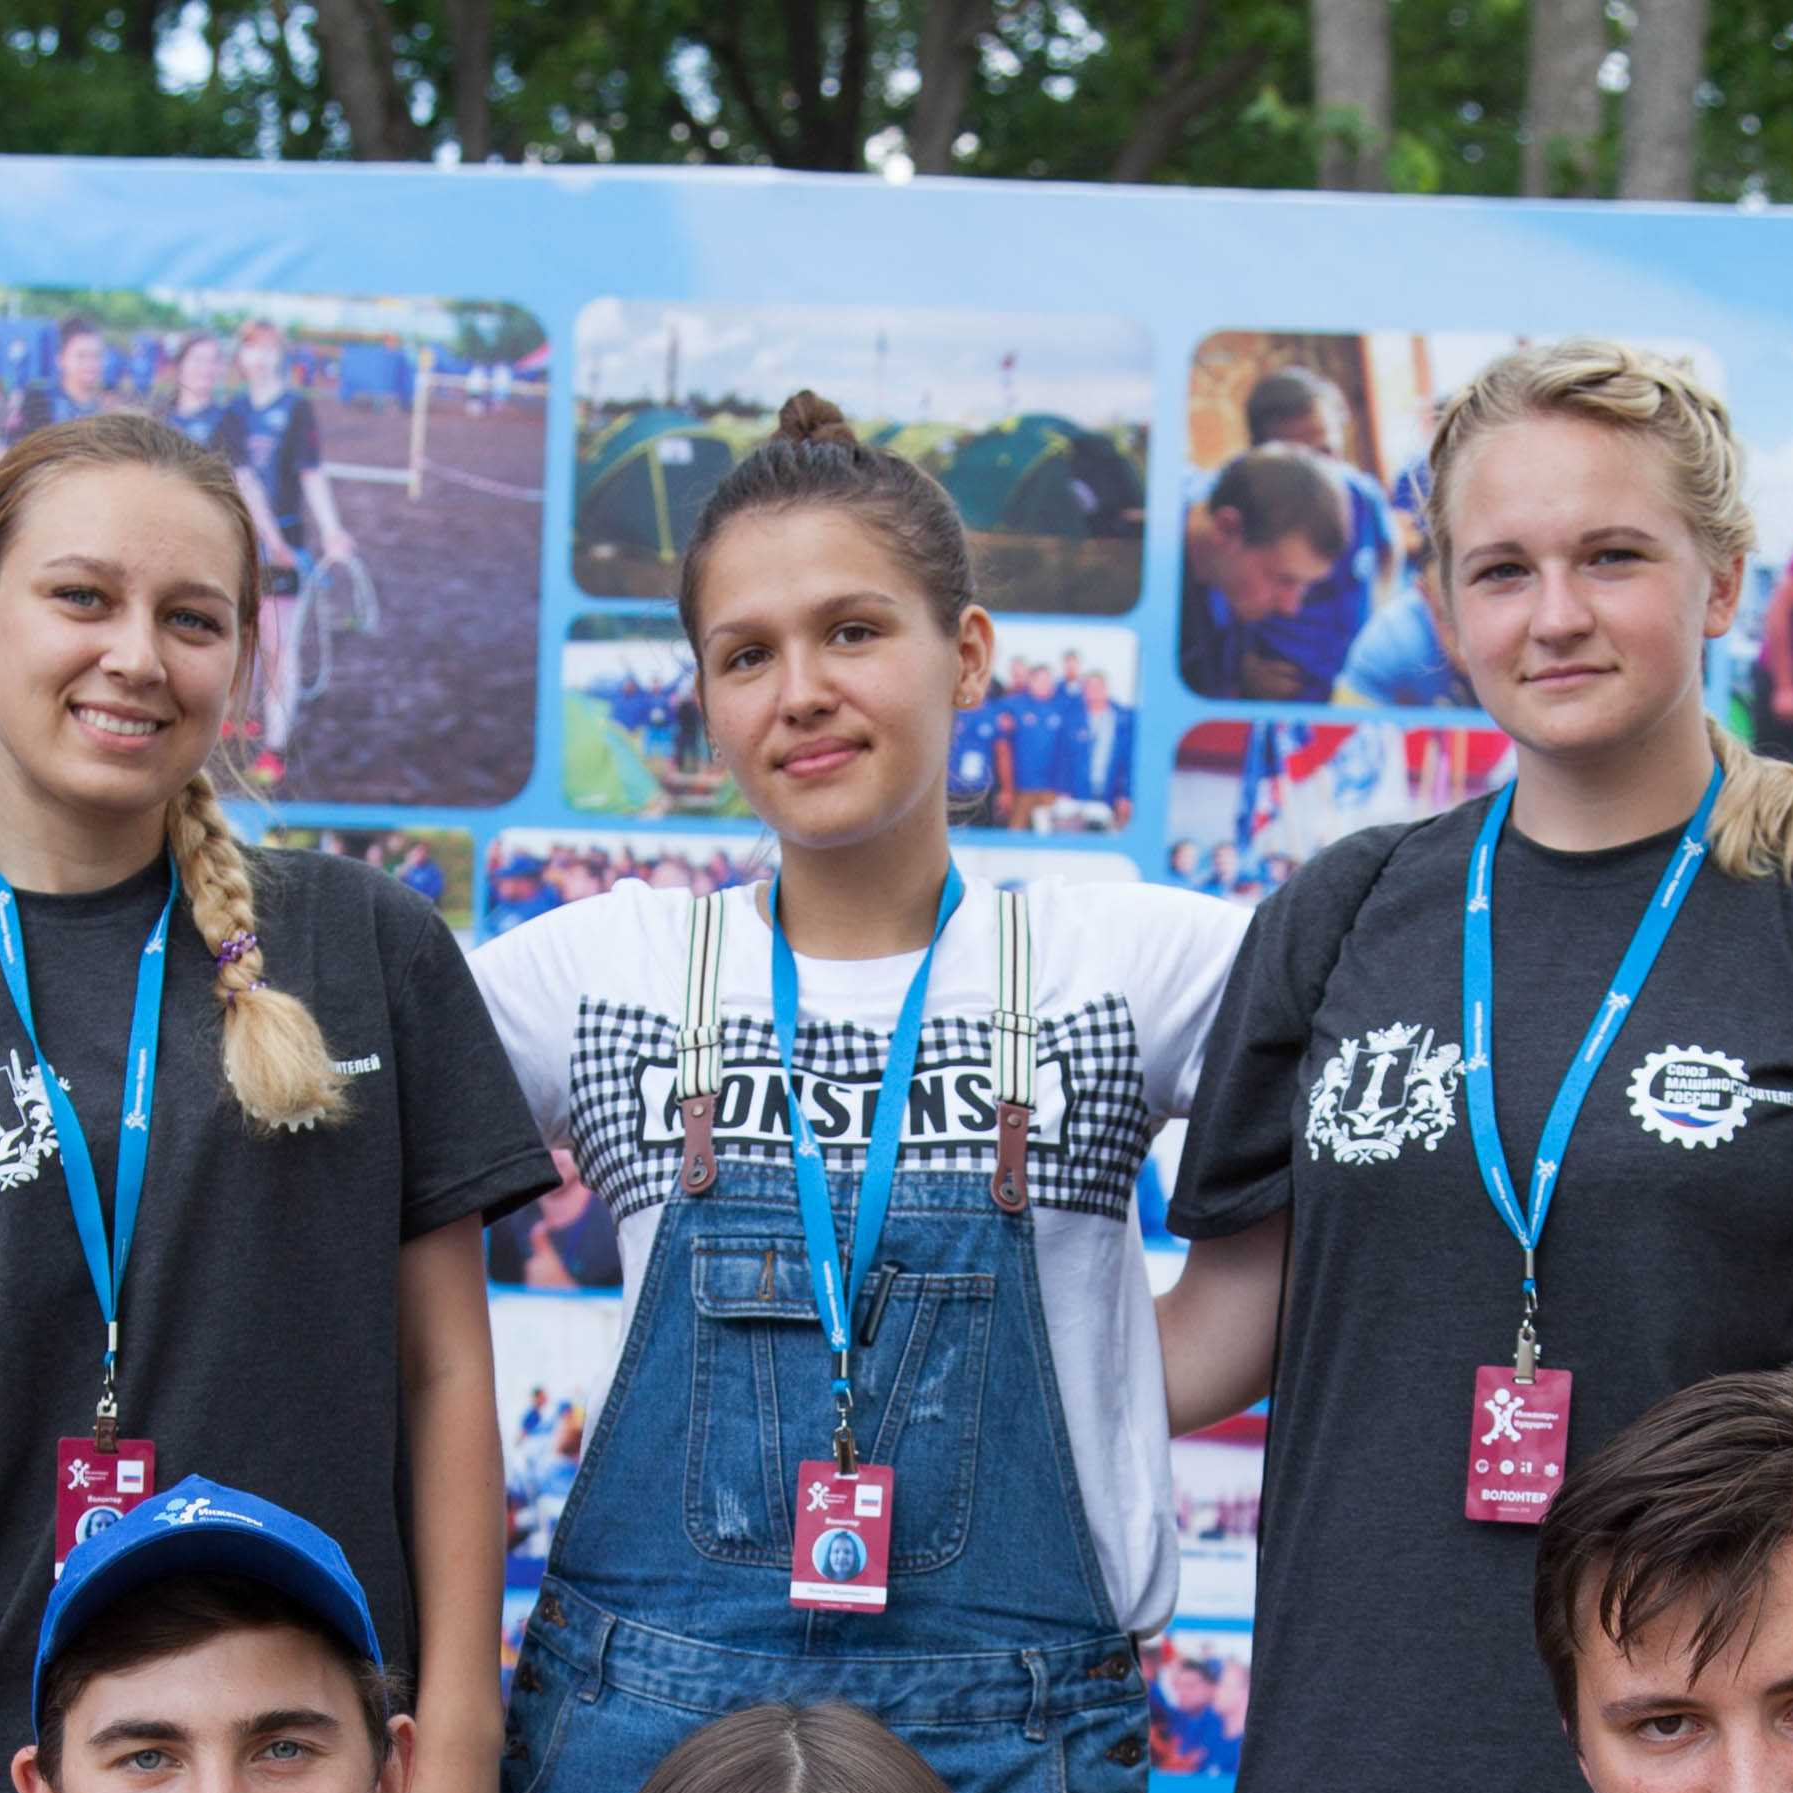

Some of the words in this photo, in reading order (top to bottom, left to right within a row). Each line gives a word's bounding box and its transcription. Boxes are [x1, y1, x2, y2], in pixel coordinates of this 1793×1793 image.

[1666, 1063, 1709, 1078] СОЮЗ
[663, 1073, 1041, 1138] ONSNS
[1663, 1090, 1721, 1107] РОССИИ
[1480, 1488, 1548, 1504] ВОЛОНТЕР
